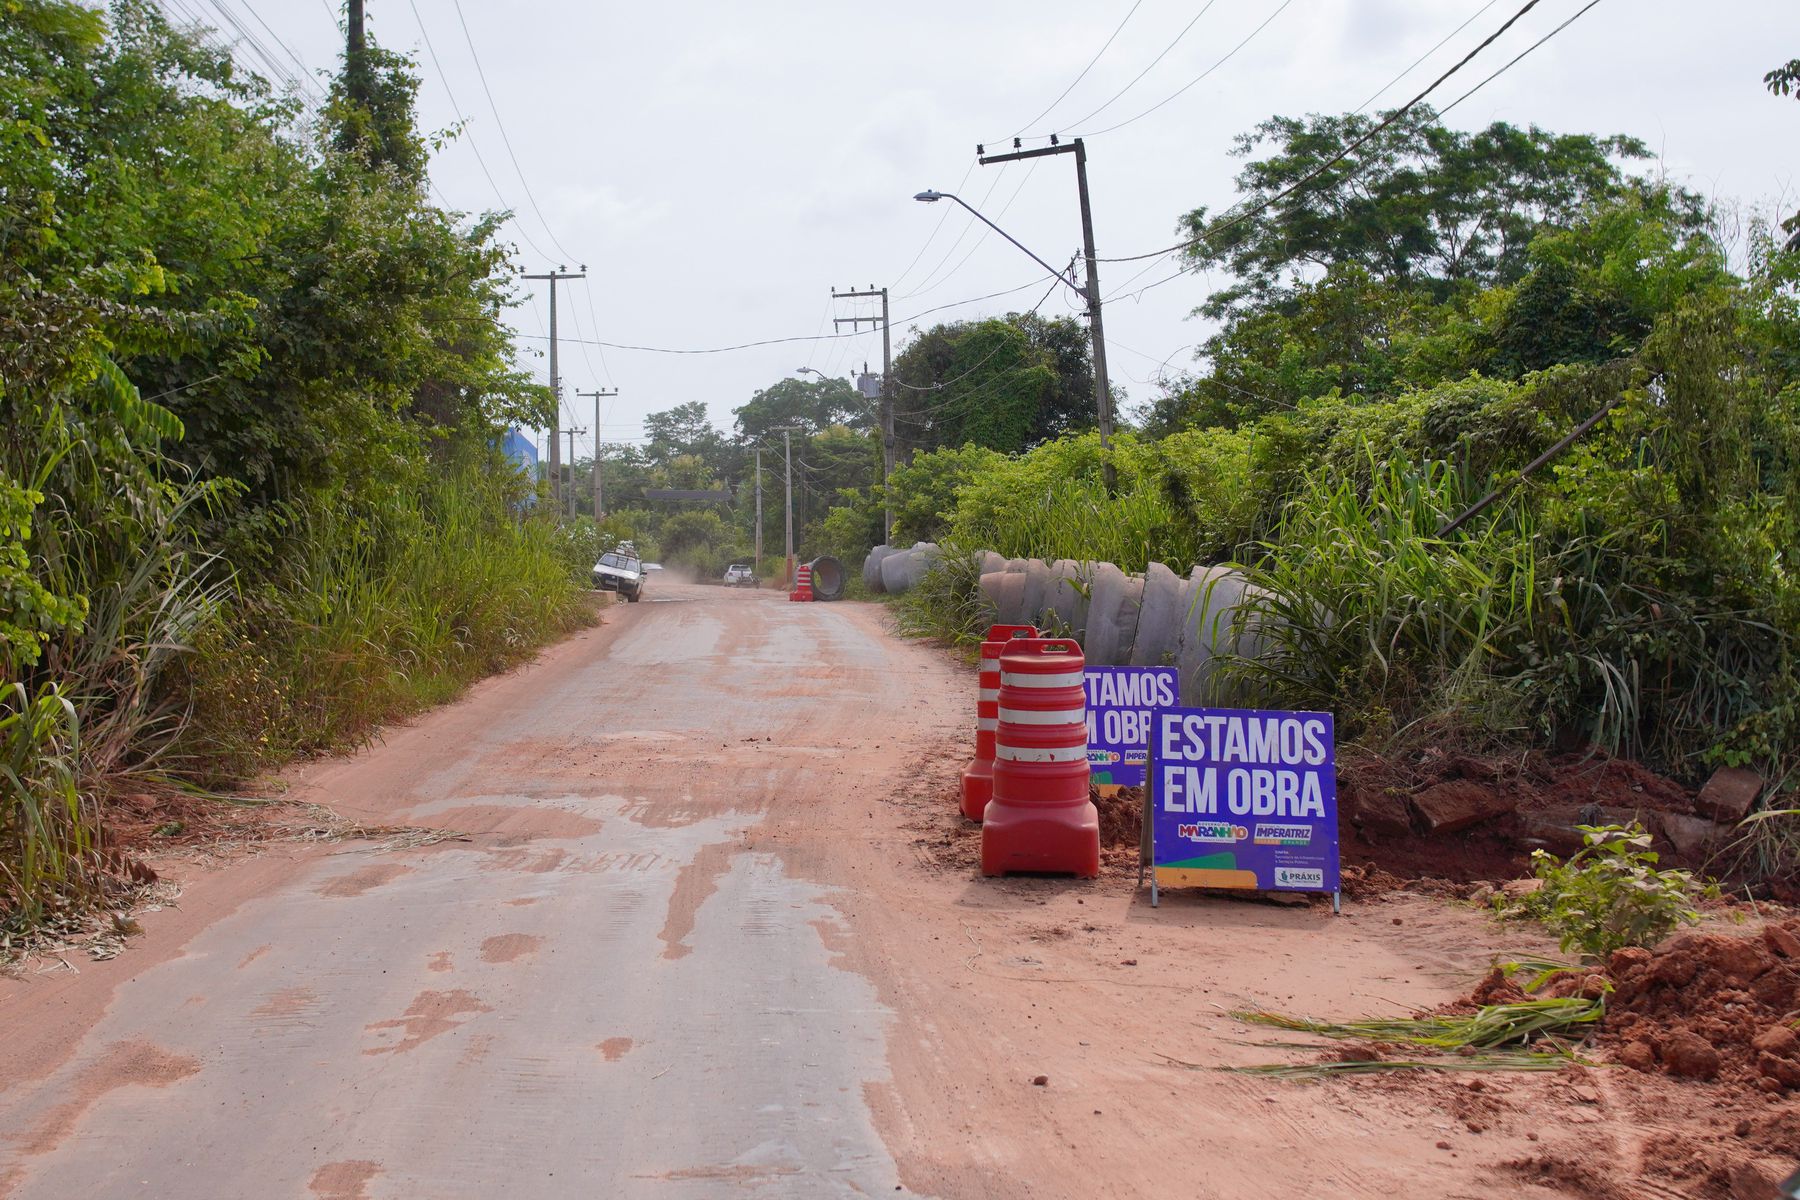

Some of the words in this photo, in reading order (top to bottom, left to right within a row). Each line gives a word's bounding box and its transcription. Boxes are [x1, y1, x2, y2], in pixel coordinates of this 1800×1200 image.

[1085, 673, 1174, 707] TAMOS
[1104, 710, 1151, 744] OBR
[1162, 714, 1326, 766] ESTAMOS
[1164, 766, 1217, 814] EM
[1228, 768, 1326, 817] OBRA
[1256, 827, 1311, 839] IMPERATRIZ
[1289, 871, 1321, 881] PRÁXIS
